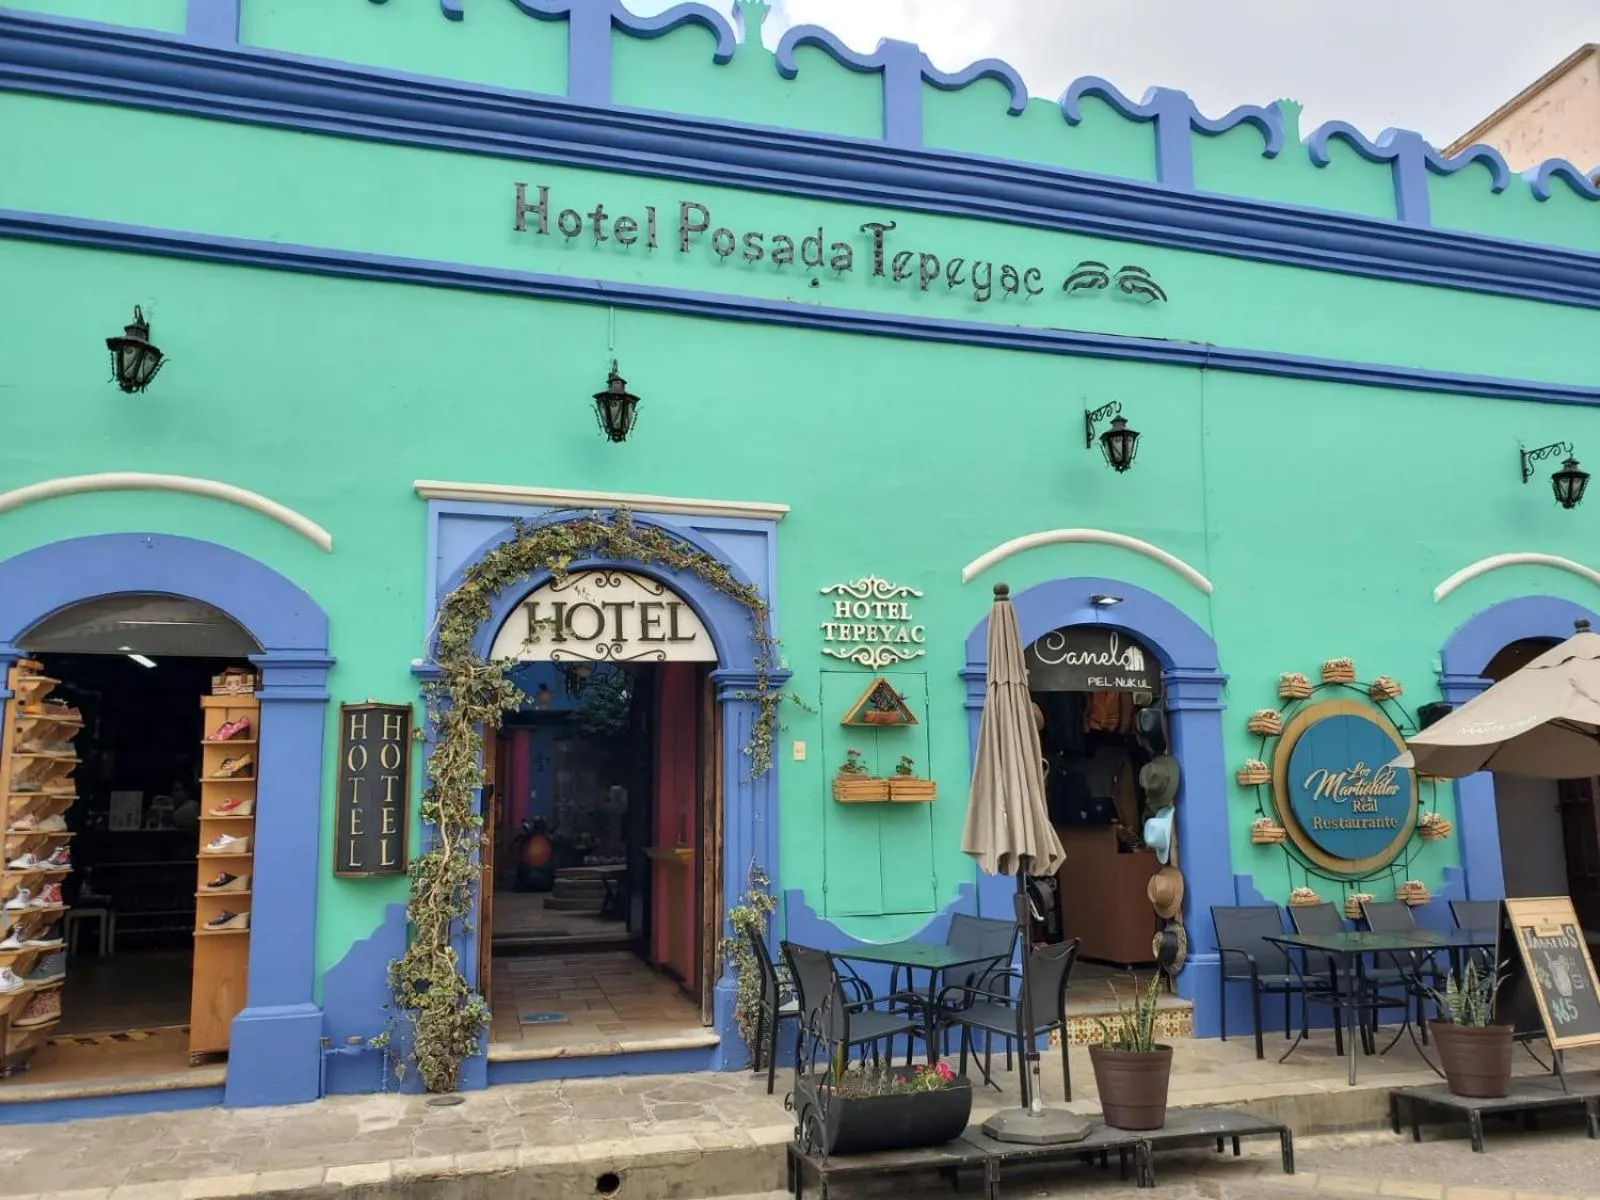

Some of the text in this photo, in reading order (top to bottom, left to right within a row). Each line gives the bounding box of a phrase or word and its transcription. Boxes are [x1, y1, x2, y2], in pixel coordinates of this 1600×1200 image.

[513, 182, 1045, 303] Hotel Posada Tepeyac
[523, 600, 698, 644] HOTEL
[833, 600, 913, 620] HOTEL
[820, 622, 926, 643] TEPEYAC
[347, 713, 368, 867] HOTEL
[379, 713, 403, 866] HOTEL
[1352, 799, 1378, 813] Real
[1313, 816, 1398, 830] Restaurante
